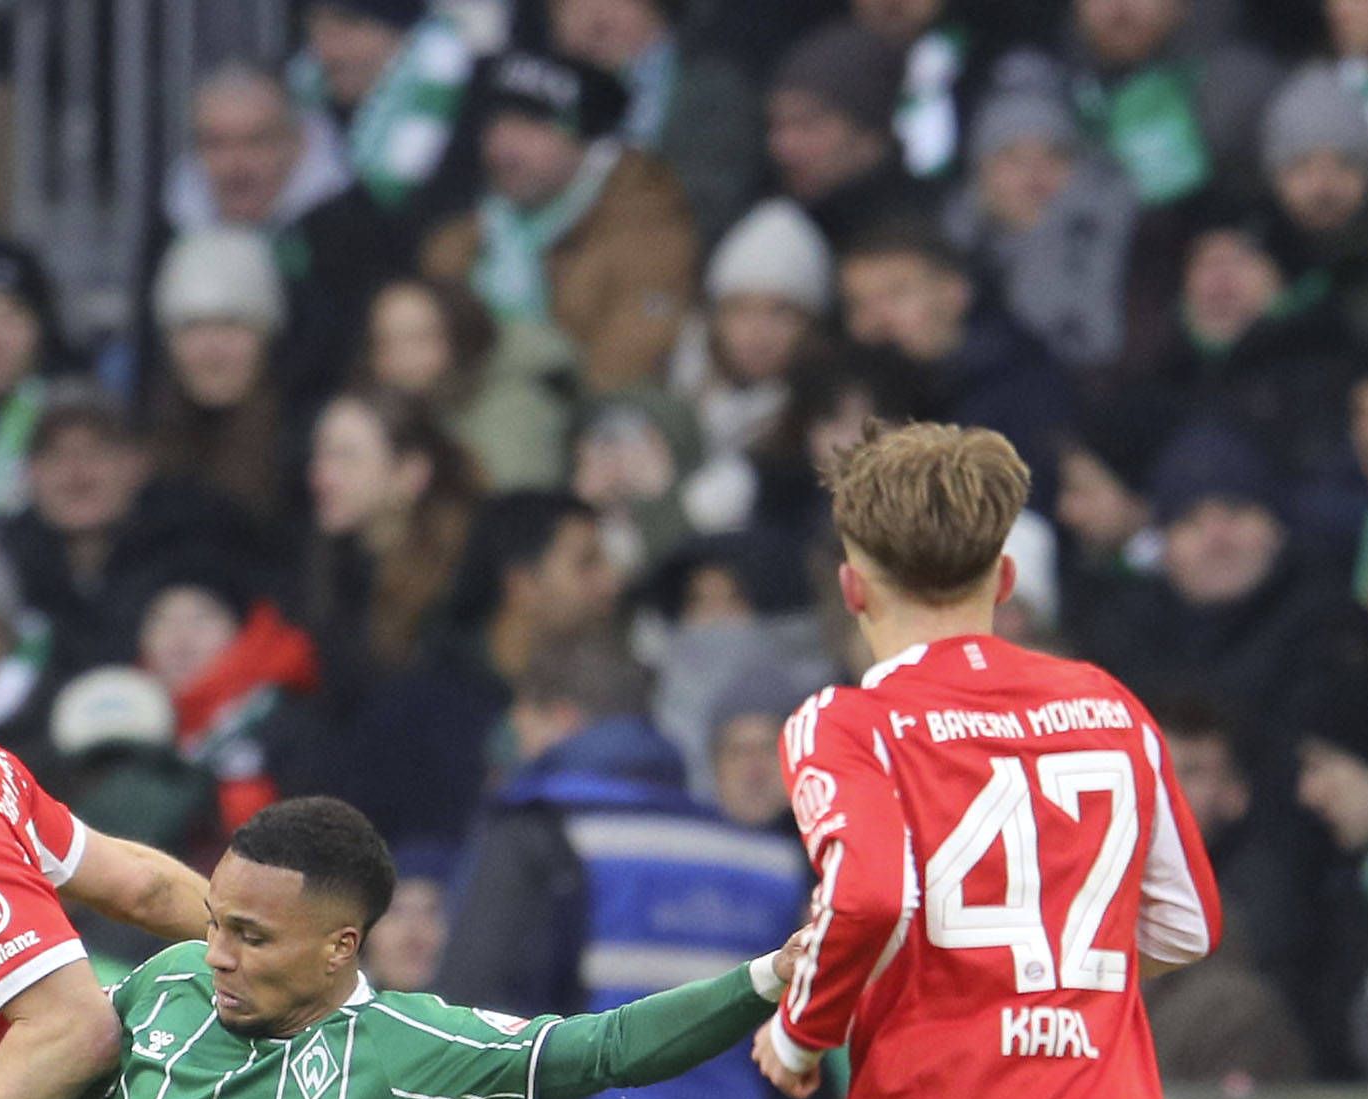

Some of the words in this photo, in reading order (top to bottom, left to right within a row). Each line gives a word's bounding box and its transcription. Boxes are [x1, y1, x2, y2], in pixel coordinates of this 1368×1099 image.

[926, 709, 1026, 743] BAYERN
[926, 751, 1140, 993] 42
[1000, 1006, 1099, 1059] KARL
